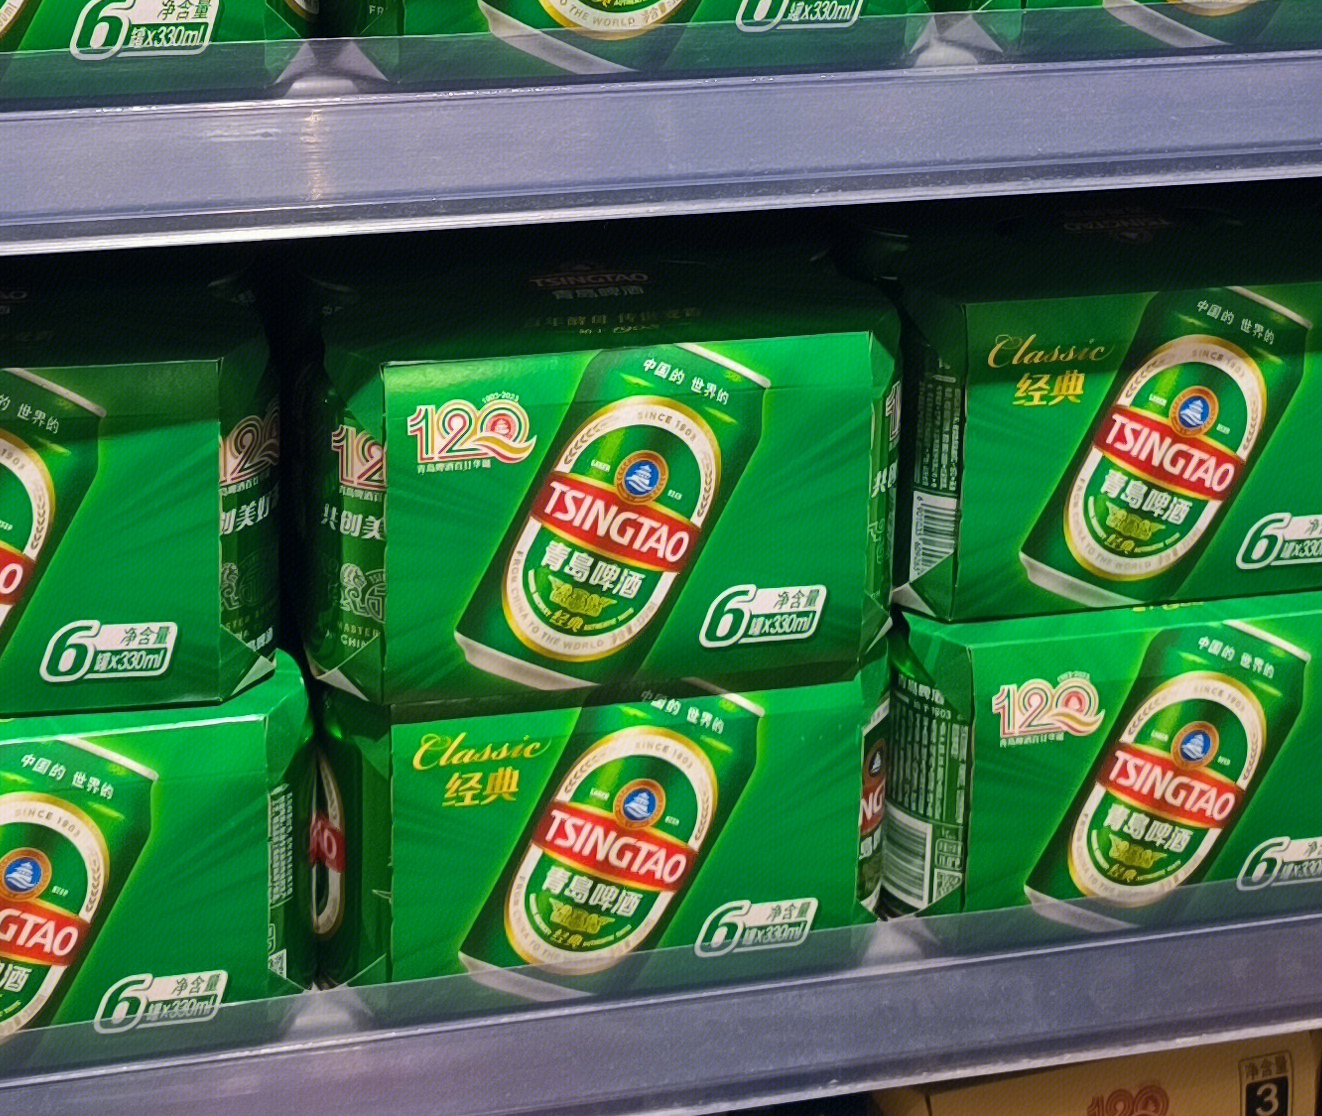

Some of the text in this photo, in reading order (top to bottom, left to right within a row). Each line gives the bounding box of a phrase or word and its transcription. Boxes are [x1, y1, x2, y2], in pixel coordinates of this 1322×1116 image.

[987, 333, 1109, 370] Classic
[1013, 372, 1085, 408] 经典
[1104, 413, 1234, 493] TSINGTAO
[544, 482, 690, 564] TSINGTAO
[541, 540, 646, 600] 青島啤酒
[413, 733, 552, 771] Classic
[442, 768, 519, 808] 经典
[1110, 750, 1235, 821] TSINGTAO
[545, 809, 686, 884] TSINGTAO
